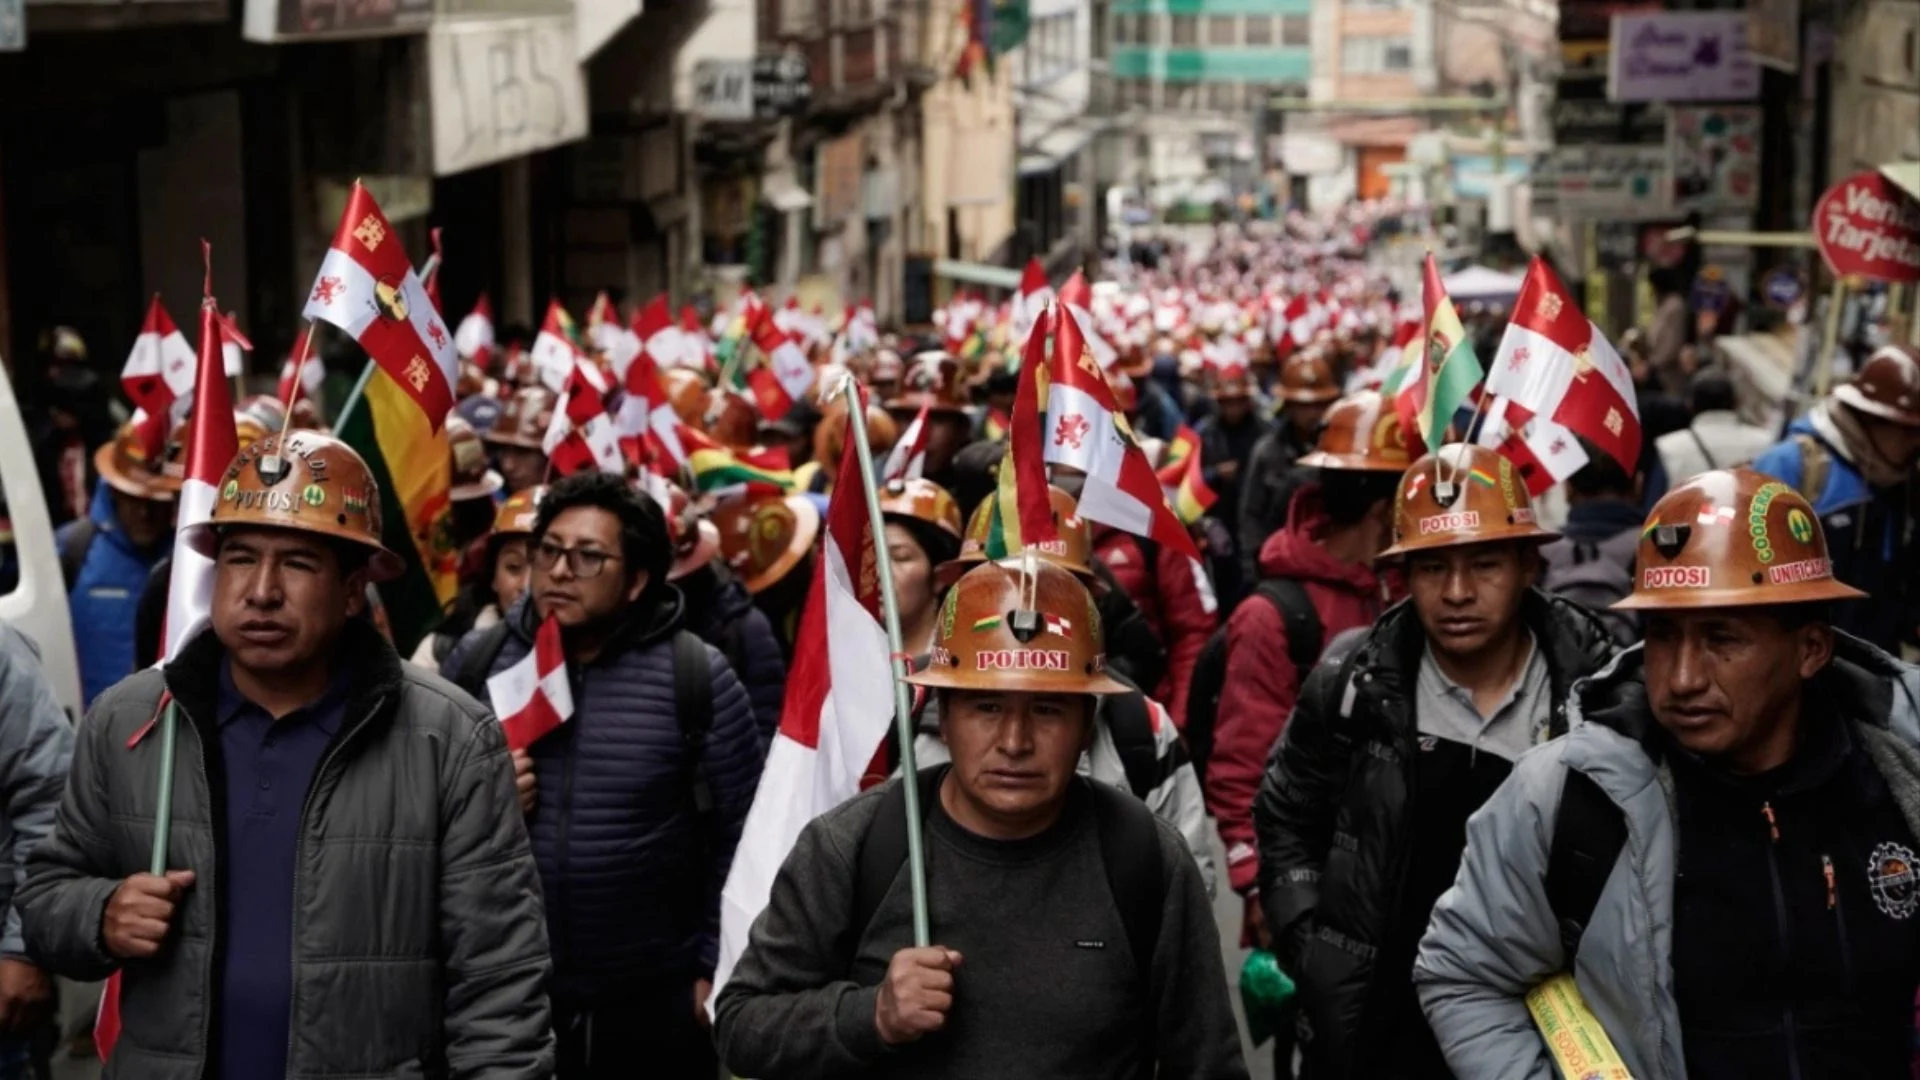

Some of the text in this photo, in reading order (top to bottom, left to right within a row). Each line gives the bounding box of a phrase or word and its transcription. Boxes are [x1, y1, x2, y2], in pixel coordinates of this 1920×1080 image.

[233, 489, 303, 514] POTOSI
[1421, 513, 1479, 534] POTOSI
[1645, 568, 1709, 587] POTOSI
[976, 650, 1070, 670] POTOSI
